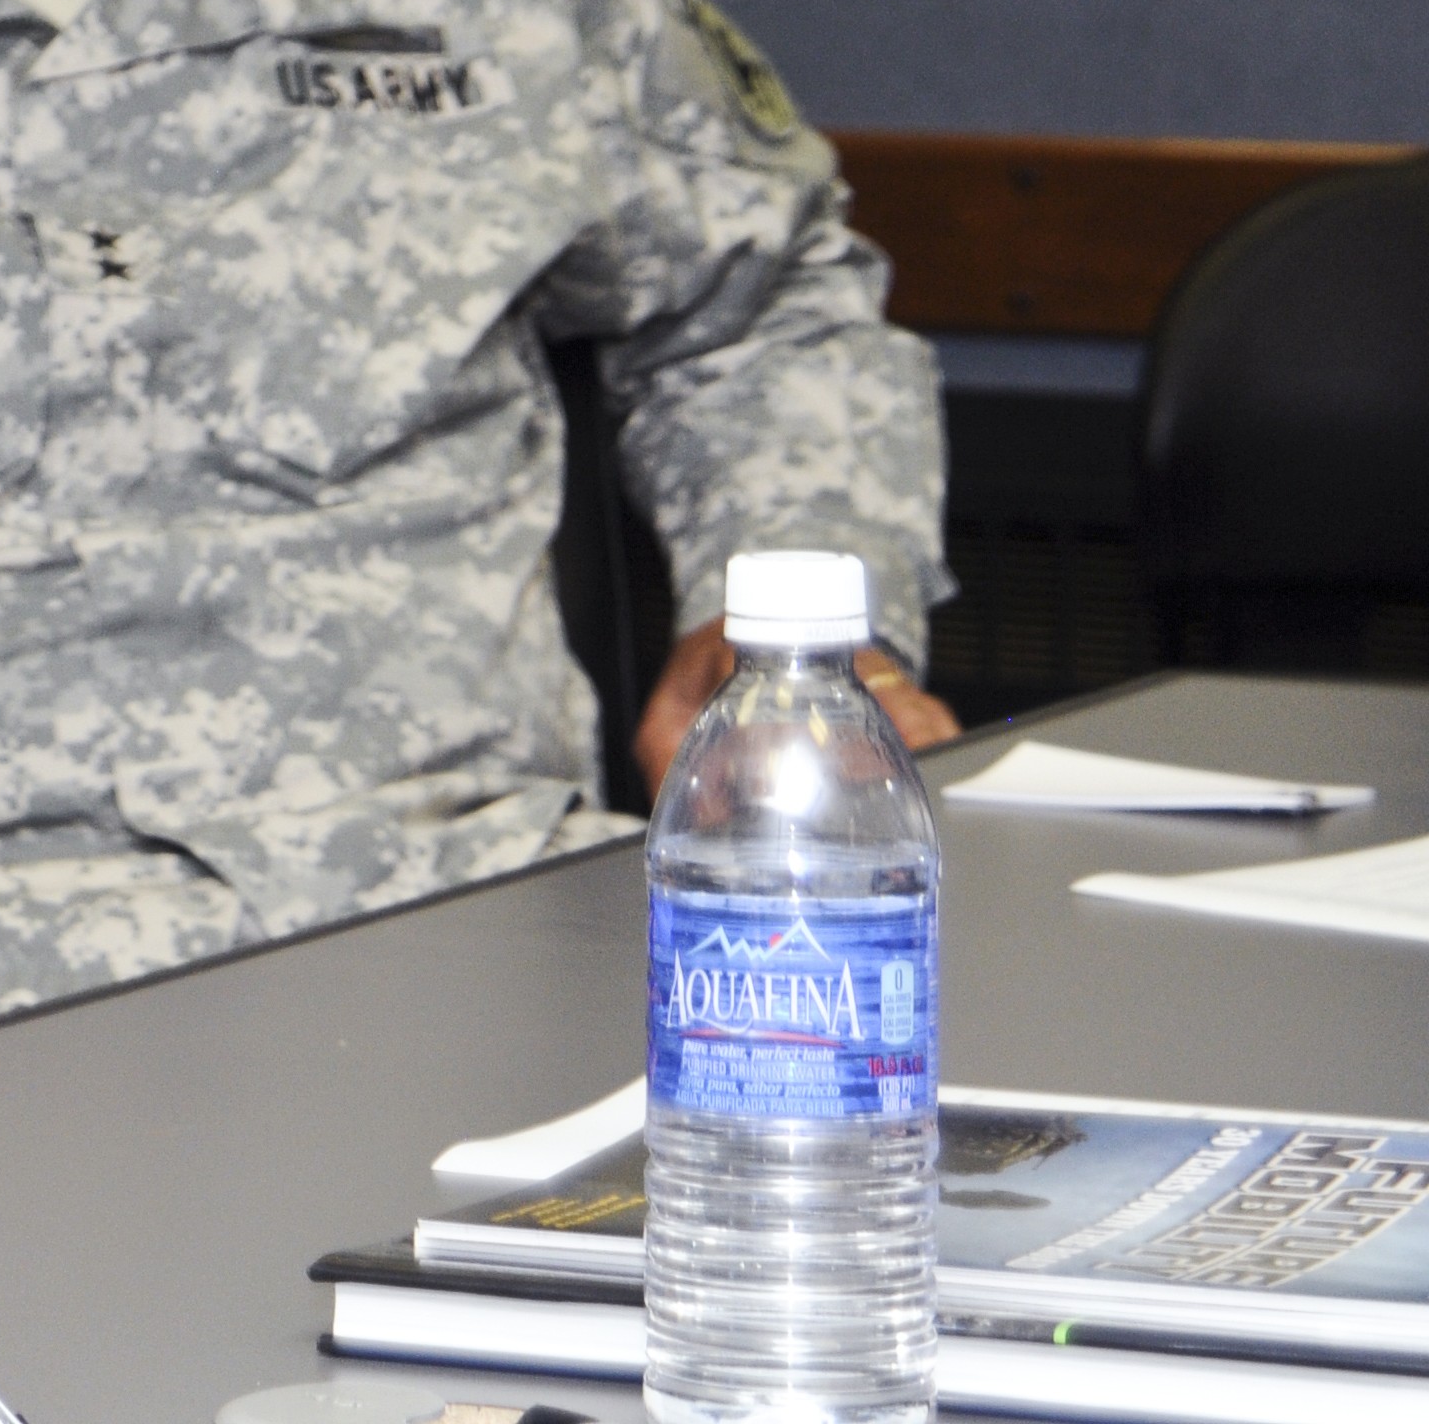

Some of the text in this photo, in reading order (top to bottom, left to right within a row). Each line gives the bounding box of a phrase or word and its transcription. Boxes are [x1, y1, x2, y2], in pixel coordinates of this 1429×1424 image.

[666, 949, 865, 1041] AQUAFINA
[681, 1056, 836, 1080] PURIFIED DRINKING WATER
[701, 1094, 767, 1113] PURIFICADA
[742, 1080, 783, 1096] sabor
[784, 1083, 841, 1098] perfecto
[1153, 1149, 1242, 1192] YEARS
[1093, 1131, 1389, 1280] MOBILITY
